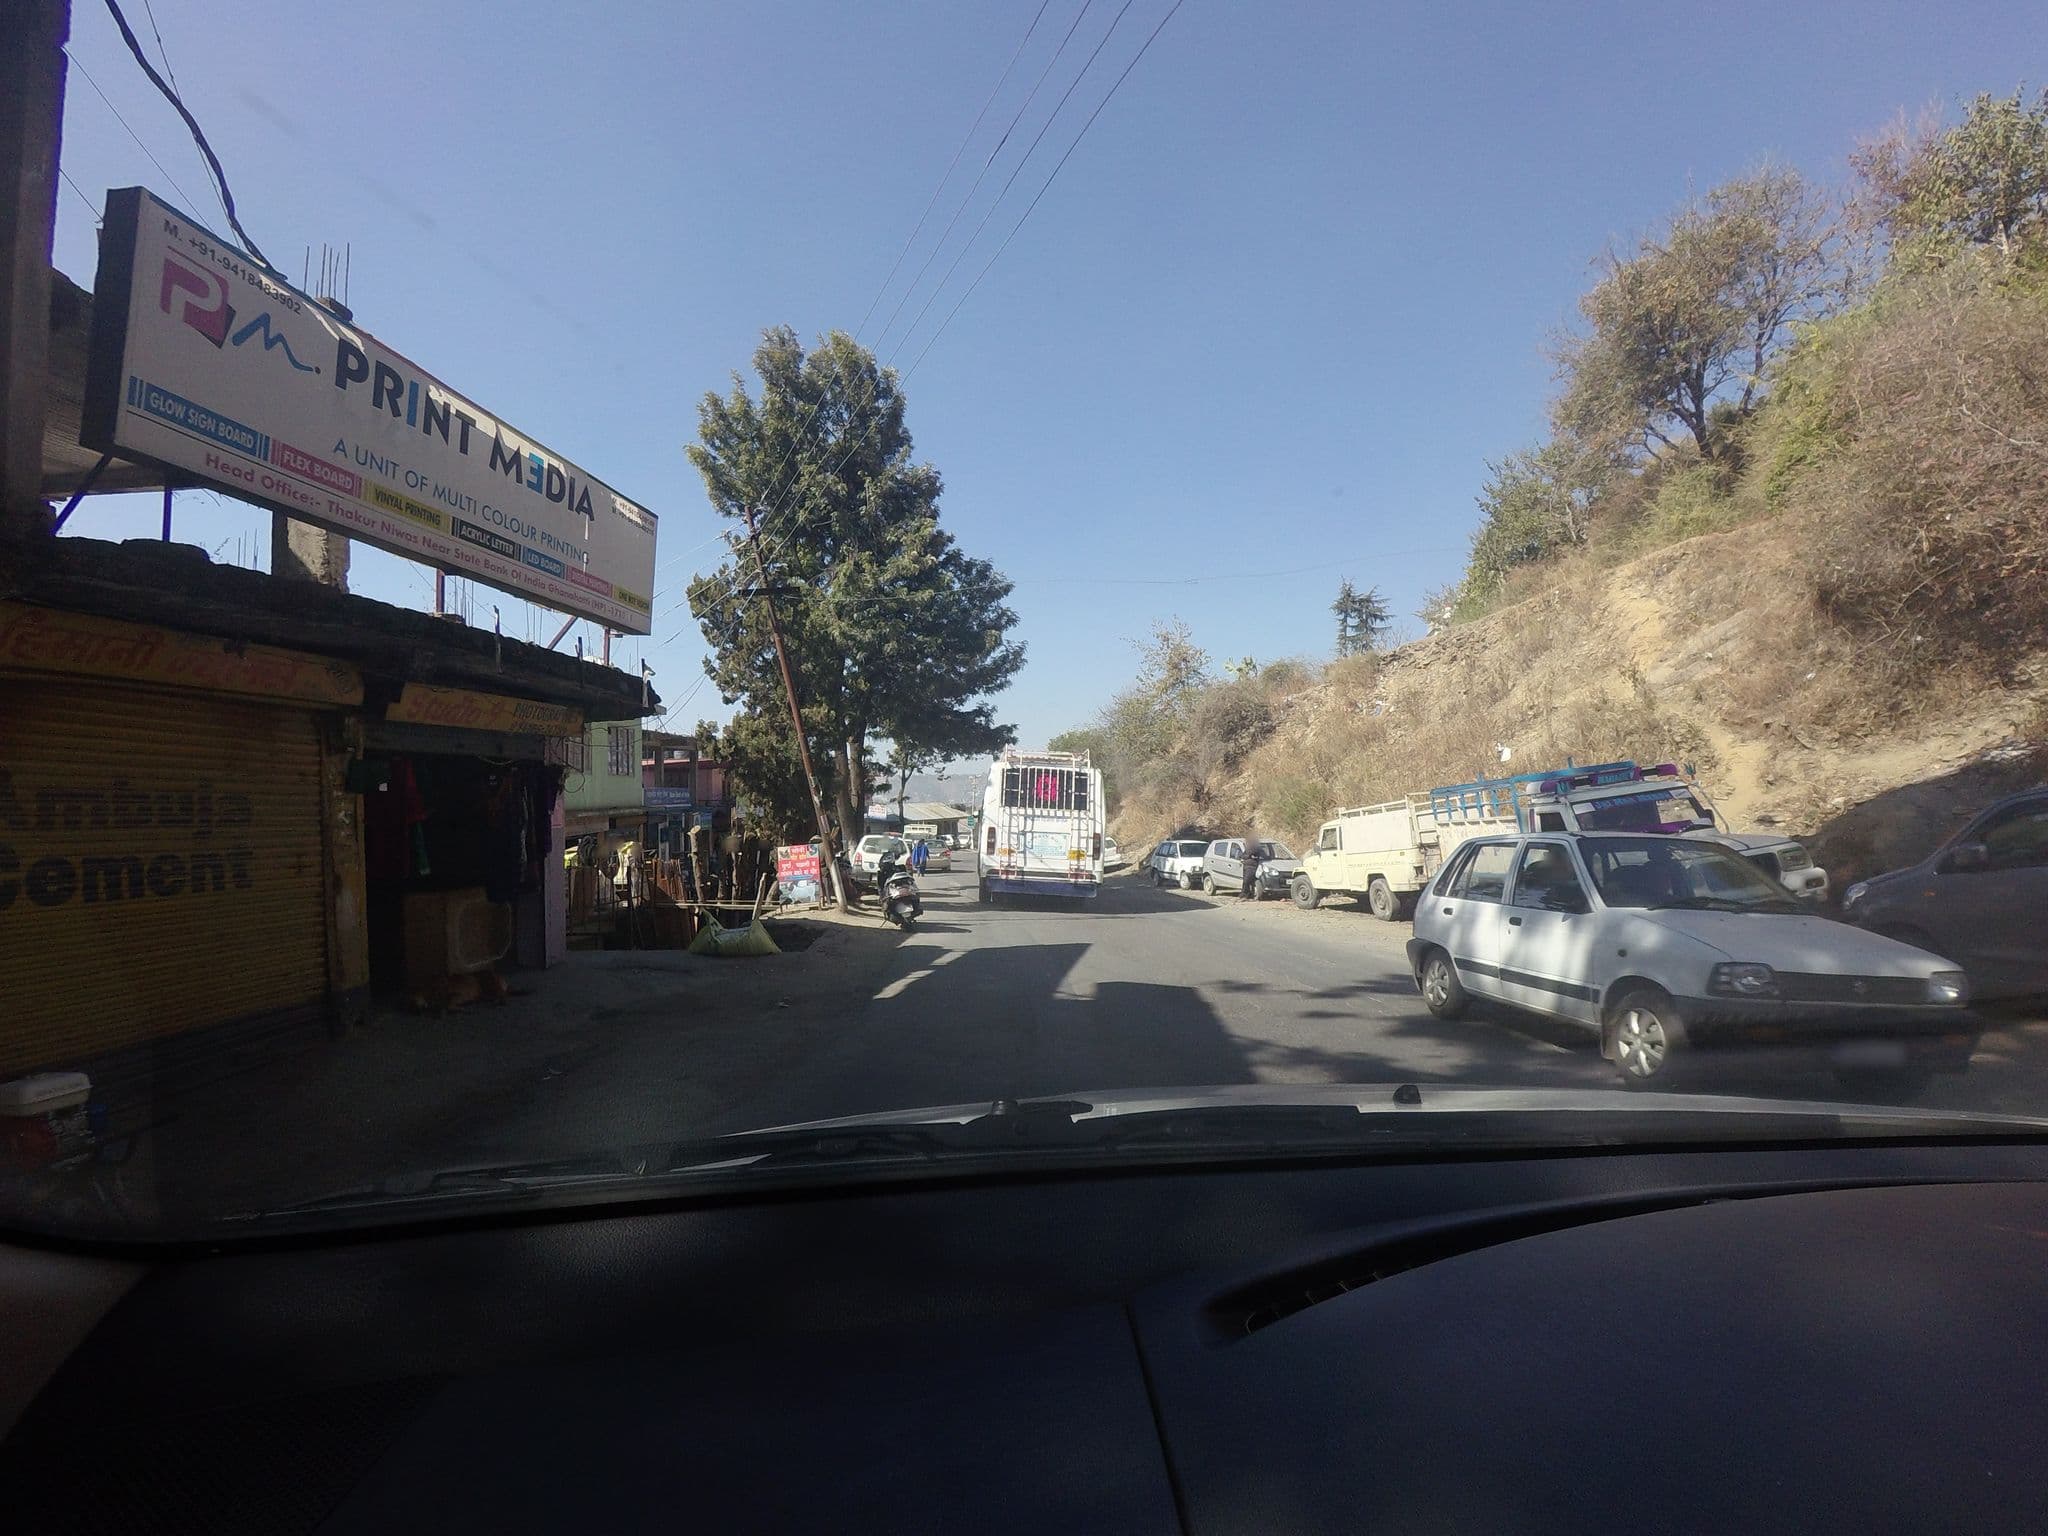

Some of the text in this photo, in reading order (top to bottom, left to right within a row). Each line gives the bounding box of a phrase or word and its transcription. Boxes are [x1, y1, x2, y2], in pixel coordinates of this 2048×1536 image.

[163, 218, 301, 316] M. +91-9418483902
[149, 391, 254, 450] GLOW SIGN BOARD
[283, 450, 353, 490] FLEX BOARD
[334, 336, 596, 524] PRINT MEDIA
[205, 452, 255, 483] Head
[327, 499, 375, 529] Thakur
[380, 520, 418, 544] Niwas
[422, 535, 450, 555] Near
[454, 547, 480, 566] State
[483, 558, 507, 576] Bank
[510, 568, 521, 580] Of
[524, 573, 545, 589] India
[333, 435, 589, 565] A UNIT OF MULTI COLOUR PRINTING
